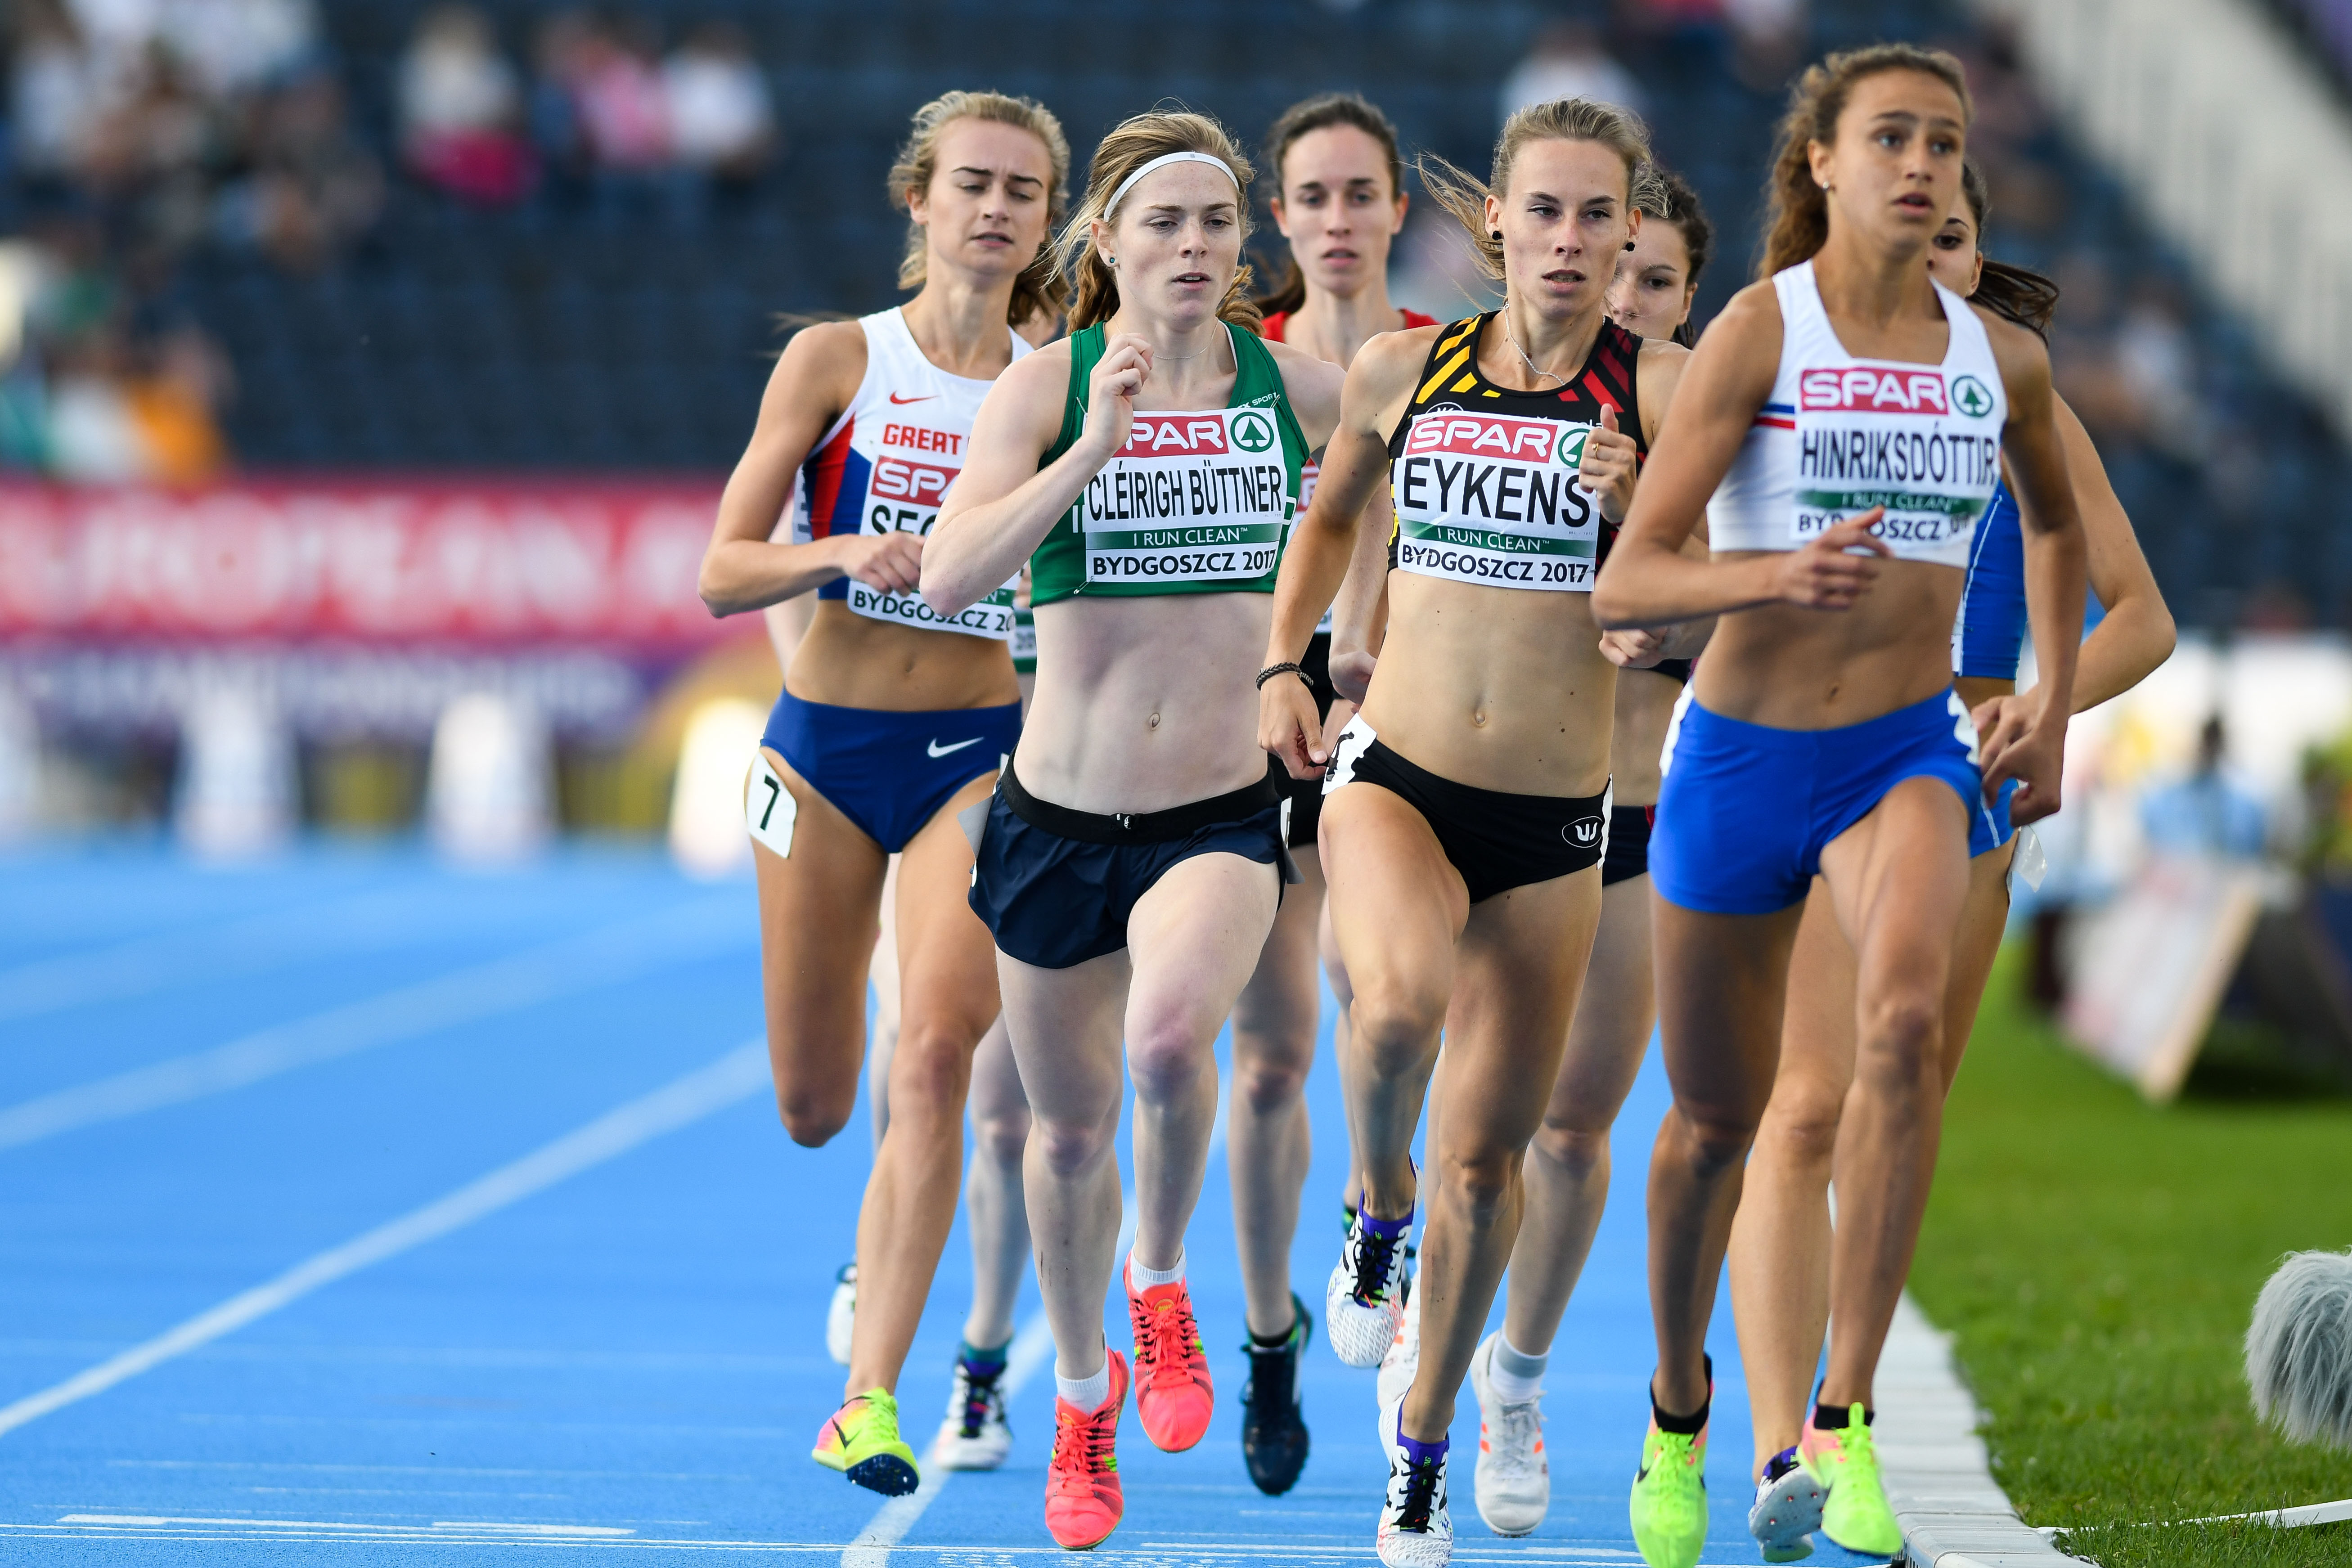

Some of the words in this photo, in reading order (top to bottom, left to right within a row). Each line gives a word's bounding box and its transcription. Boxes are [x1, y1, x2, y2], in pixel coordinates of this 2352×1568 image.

[1252, 392, 1277, 406] SPORT
[1801, 371, 1946, 410] SPAR
[883, 423, 962, 455] GREAT
[1125, 420, 1224, 451] PAR
[1411, 419, 1551, 458] SPAR
[1801, 421, 1995, 485] HINRIKSDÓTTIR
[1088, 460, 1185, 521] CLÉIRIGH
[1188, 459, 1282, 516] BÜTTNER
[1403, 457, 1591, 528] EYKENS
[1133, 533, 1138, 546] I
[1144, 530, 1179, 546] RUN
[1438, 528, 1441, 539] I
[1448, 529, 1481, 545] RUN
[1799, 512, 1941, 540] BYDOSZCZ
[1093, 552, 1237, 575] BYDGOSZCZ
[1242, 549, 1276, 571] 2017
[1402, 544, 1534, 581] BYDGOSZCZ
[1540, 562, 1590, 584] 2017
[760, 773, 780, 831] 7
